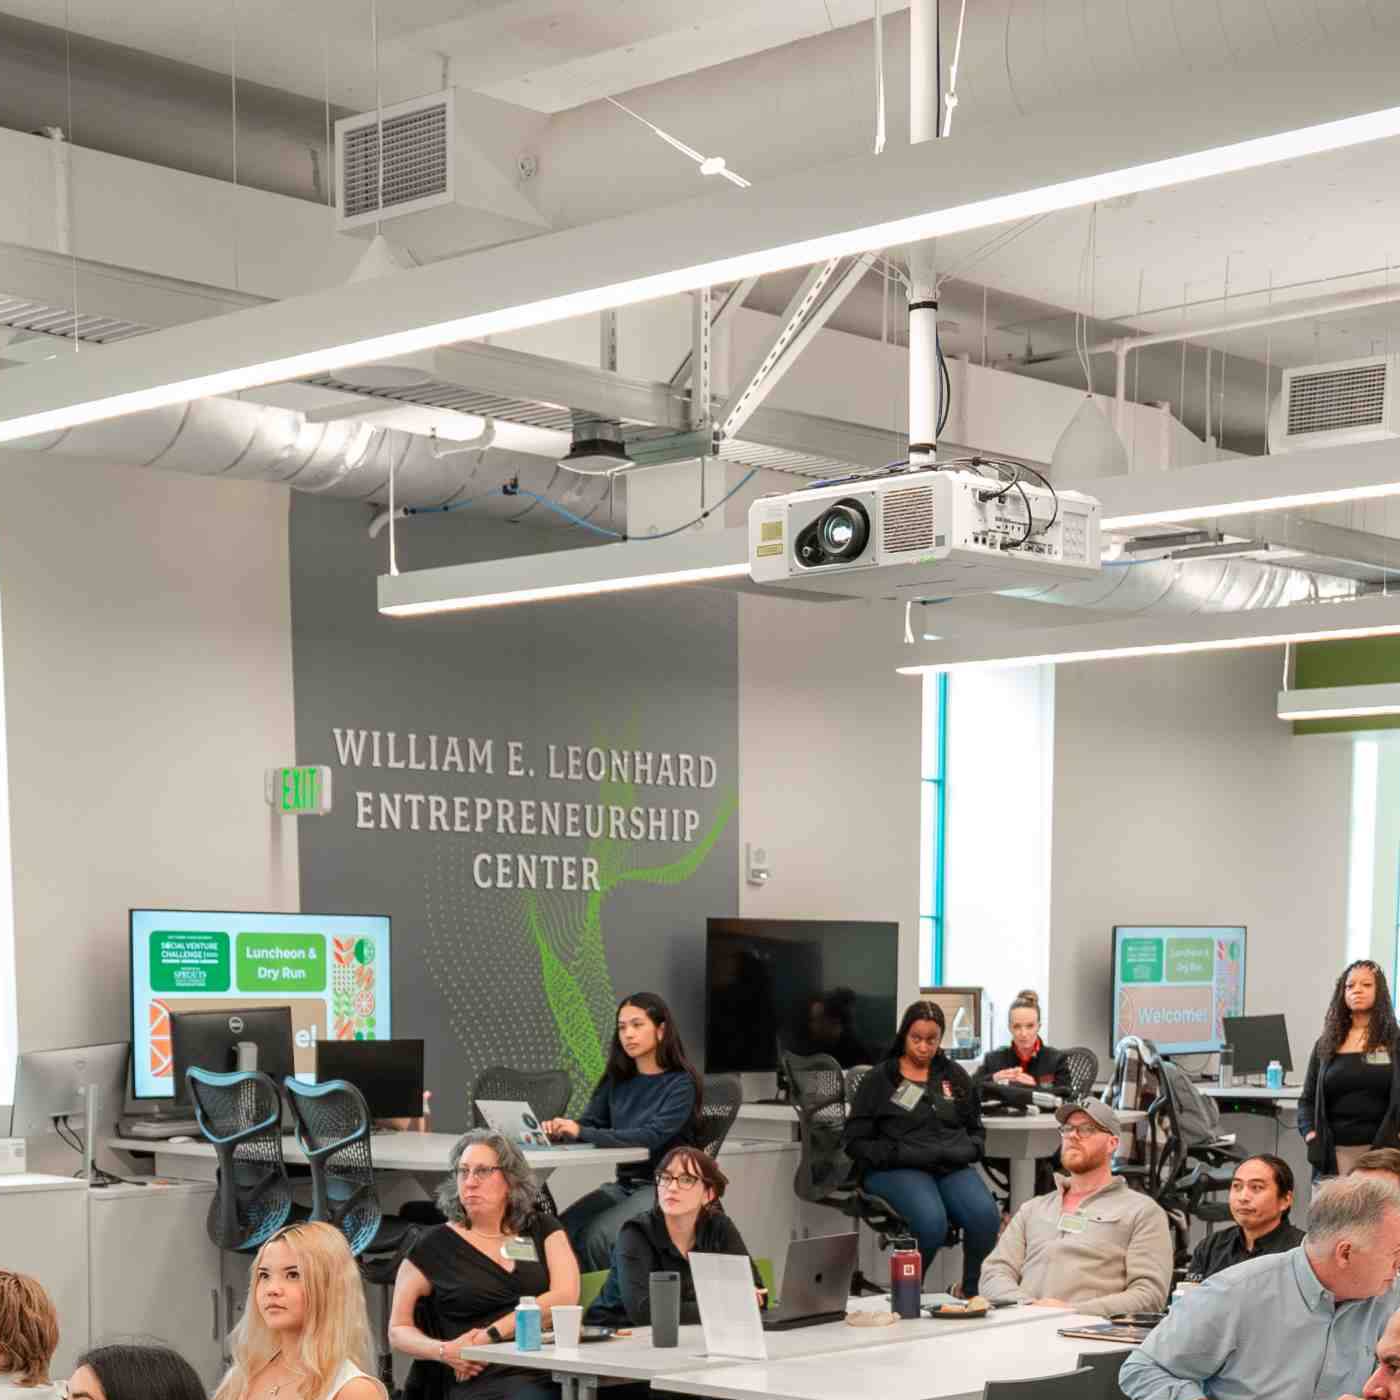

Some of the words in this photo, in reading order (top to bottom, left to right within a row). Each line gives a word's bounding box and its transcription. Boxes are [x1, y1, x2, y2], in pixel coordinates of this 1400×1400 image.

[333, 728, 493, 774] WILLIAM
[508, 742, 535, 777] E.
[549, 744, 717, 788] LEONHARD
[282, 768, 318, 809] EXIT
[355, 791, 700, 842] ENTREPRENEURSHIP
[473, 853, 601, 891] CENTER
[246, 947, 306, 960] Luncheon
[307, 948, 317, 959] &
[257, 967, 279, 980] Dry
[283, 967, 306, 979] Run
